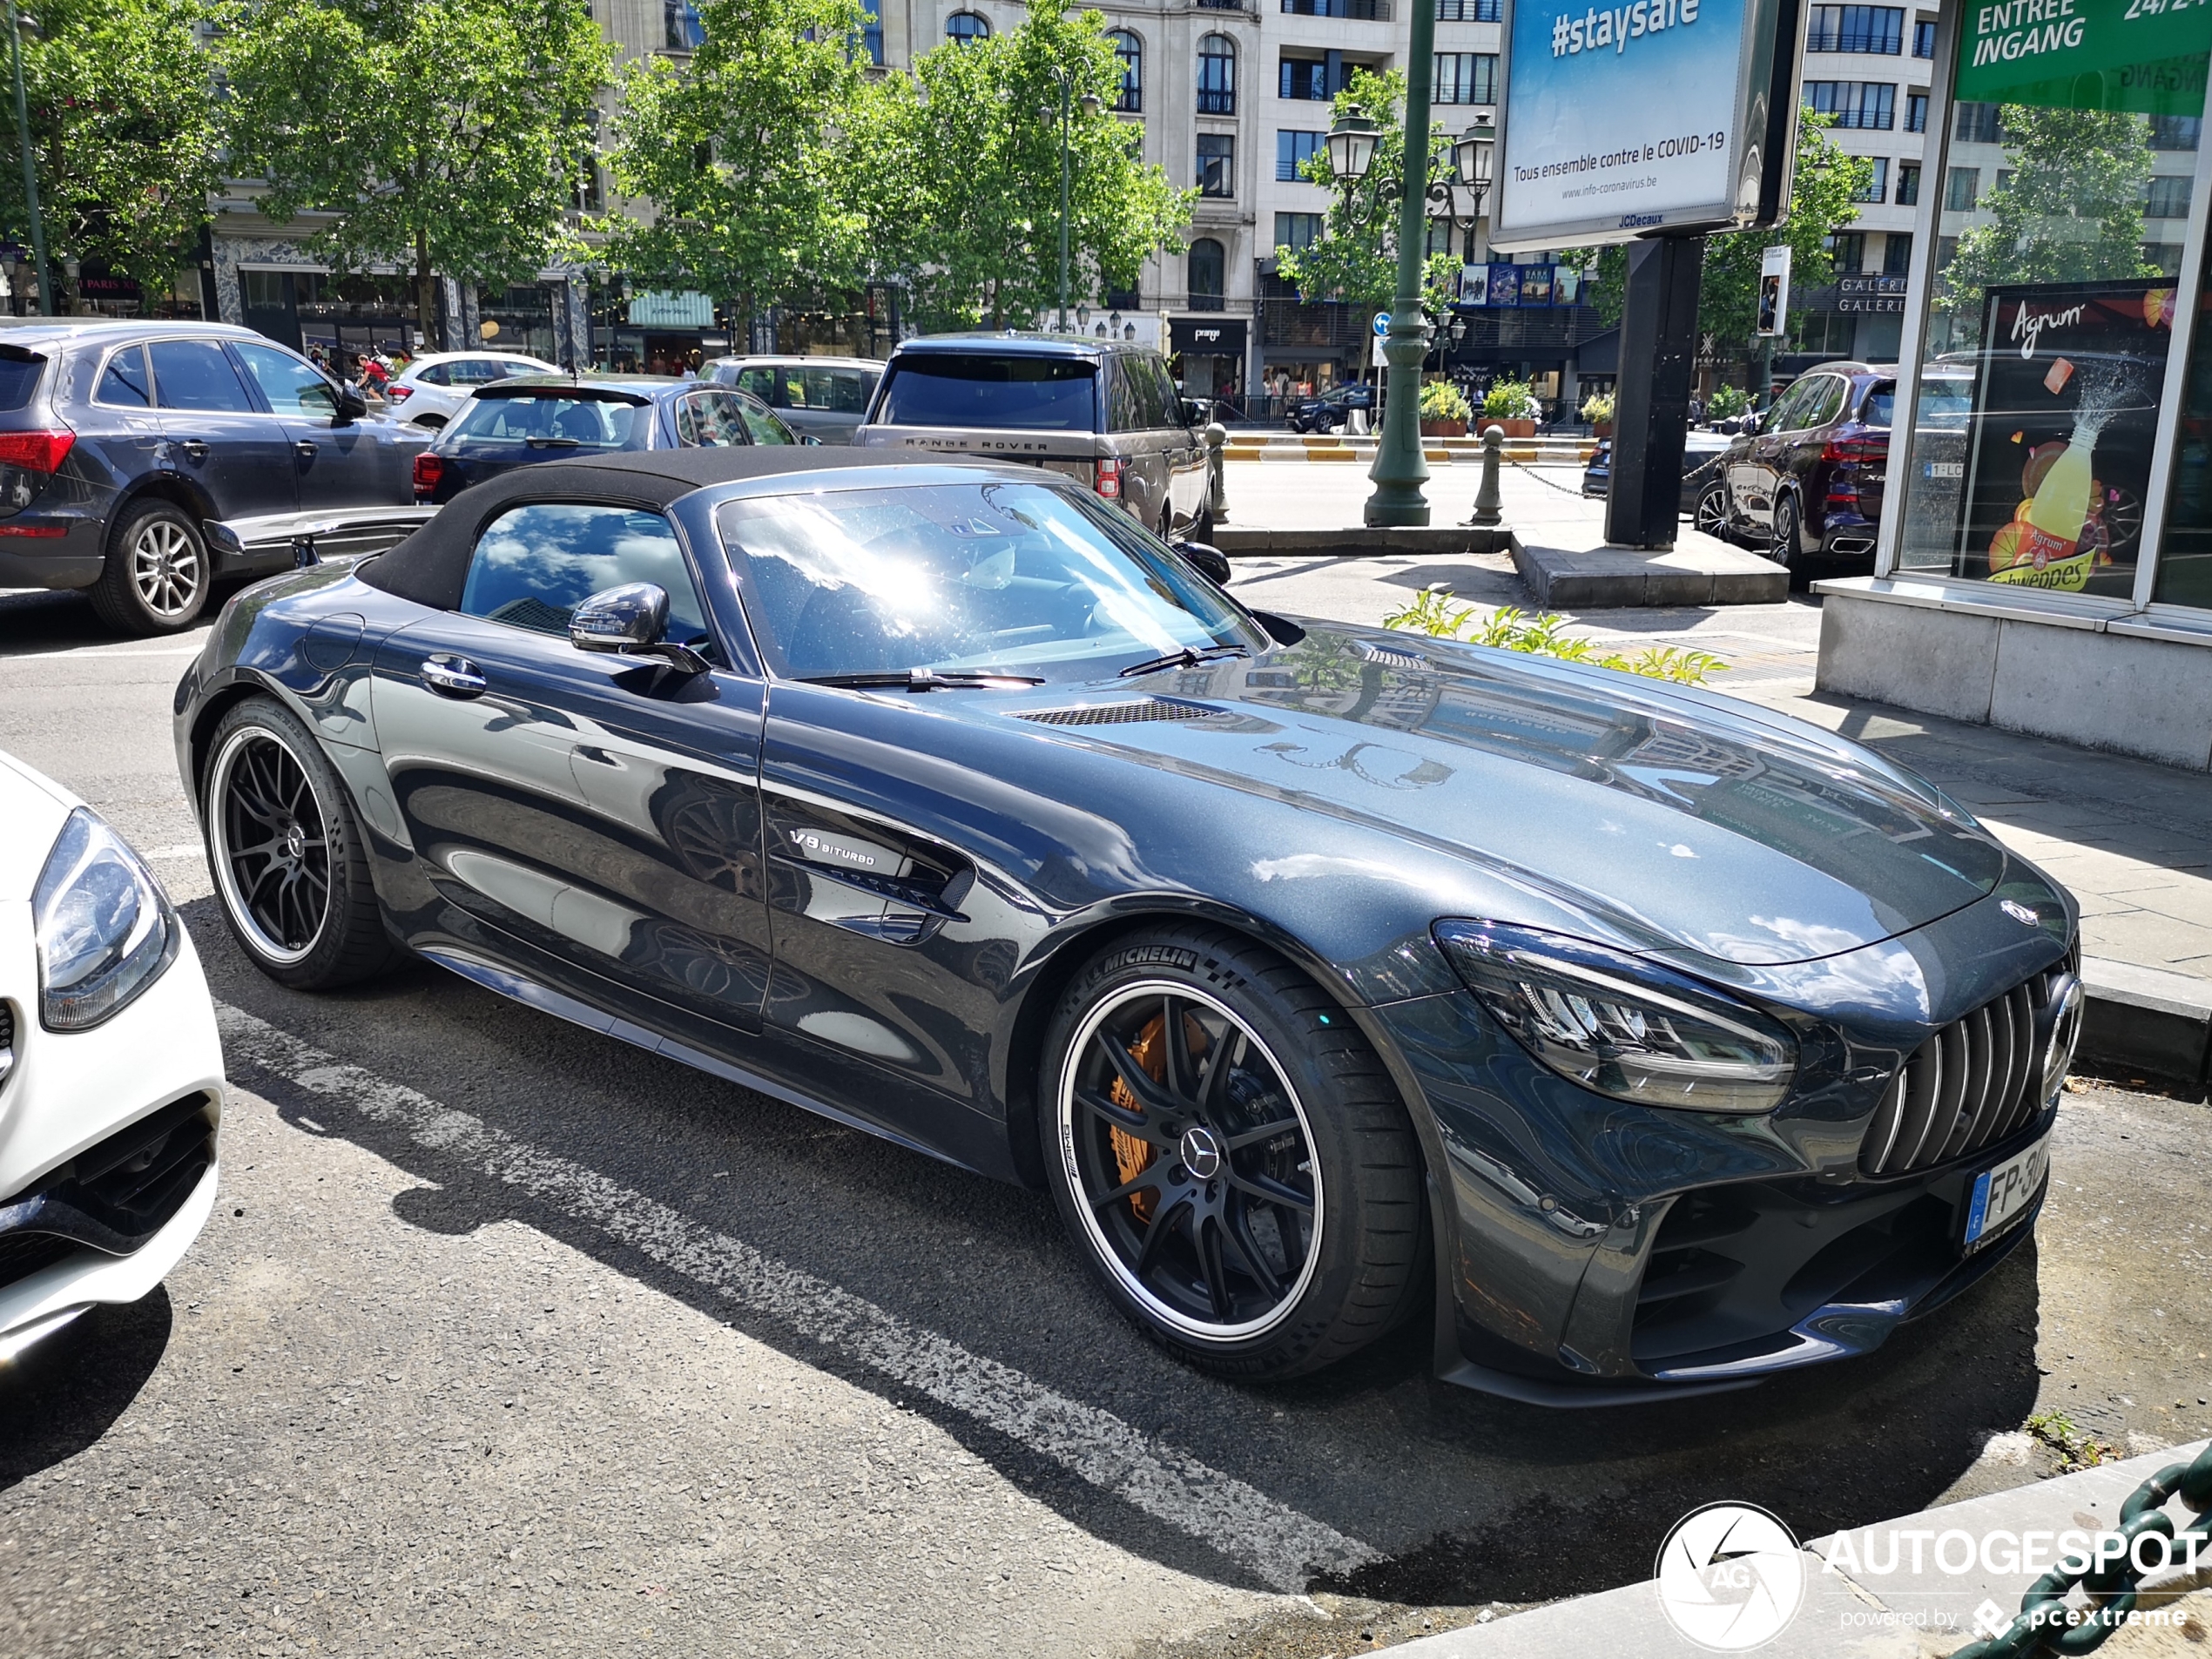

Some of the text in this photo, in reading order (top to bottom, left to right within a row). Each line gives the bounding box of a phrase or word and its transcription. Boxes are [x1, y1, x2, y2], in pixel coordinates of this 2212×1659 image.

[1973, 17, 2086, 67] INGANG
[1514, 132, 1724, 182] Tous ensemble contre le COVID-19
[1561, 176, 1656, 199] www.info-coronavirus.be
[1619, 214, 1662, 227] JCDecaux
[88, 280, 118, 289] PARIS
[906, 438, 1048, 450] RANGE ROVER
[1993, 563, 2084, 590] hweppes
[789, 830, 875, 866] V8 BITURBO
[1104, 946, 1197, 974] MICHELIN
